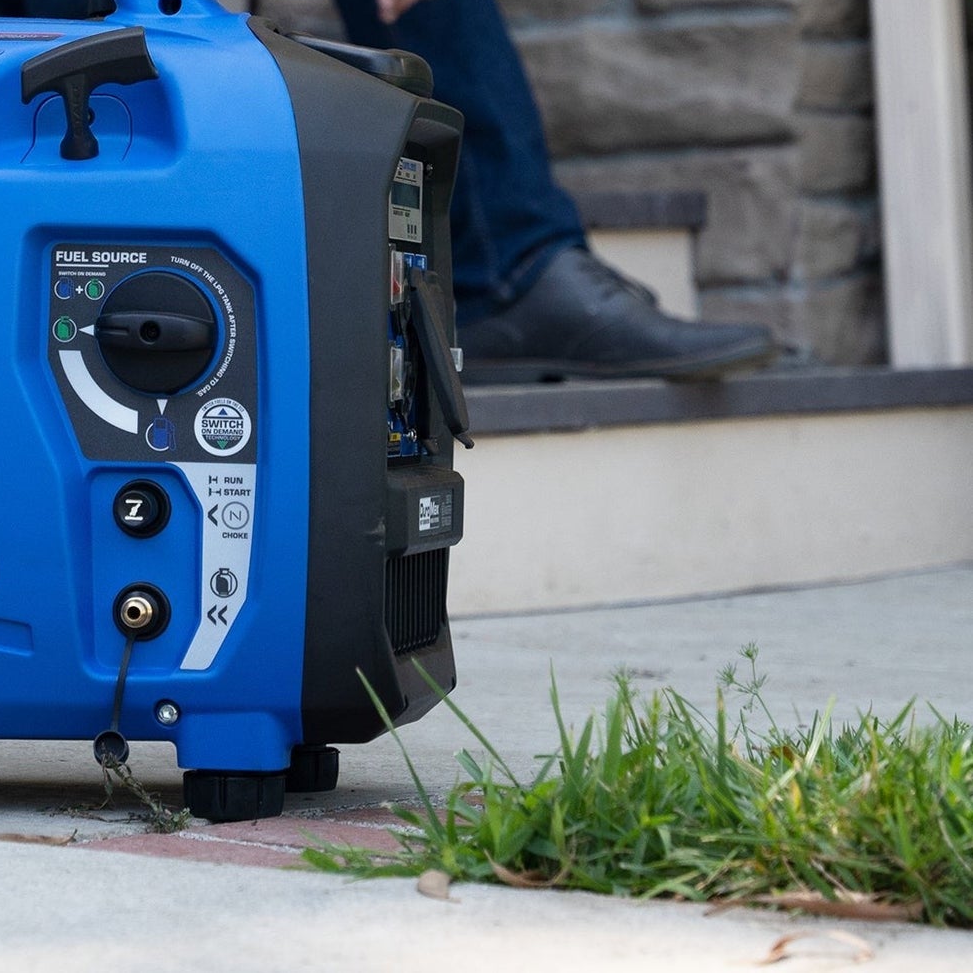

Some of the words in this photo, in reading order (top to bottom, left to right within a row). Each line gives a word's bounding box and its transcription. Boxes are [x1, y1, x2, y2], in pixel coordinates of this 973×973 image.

[56, 251, 89, 262] FUEL
[92, 251, 147, 263] SOURCE
[170, 256, 190, 267] TURN
[190, 262, 204, 273] OFF
[202, 270, 215, 283] THE
[212, 281, 225, 295] LPG
[222, 294, 234, 314] TANK
[228, 315, 237, 338] AFTER
[216, 338, 236, 378] SWITCHING
[209, 376, 219, 387] TO
[201, 419, 244, 429] SWITCH
[224, 476, 244, 485] RUN
[224, 488, 252, 497] START
[222, 531, 249, 540] CHOKE
